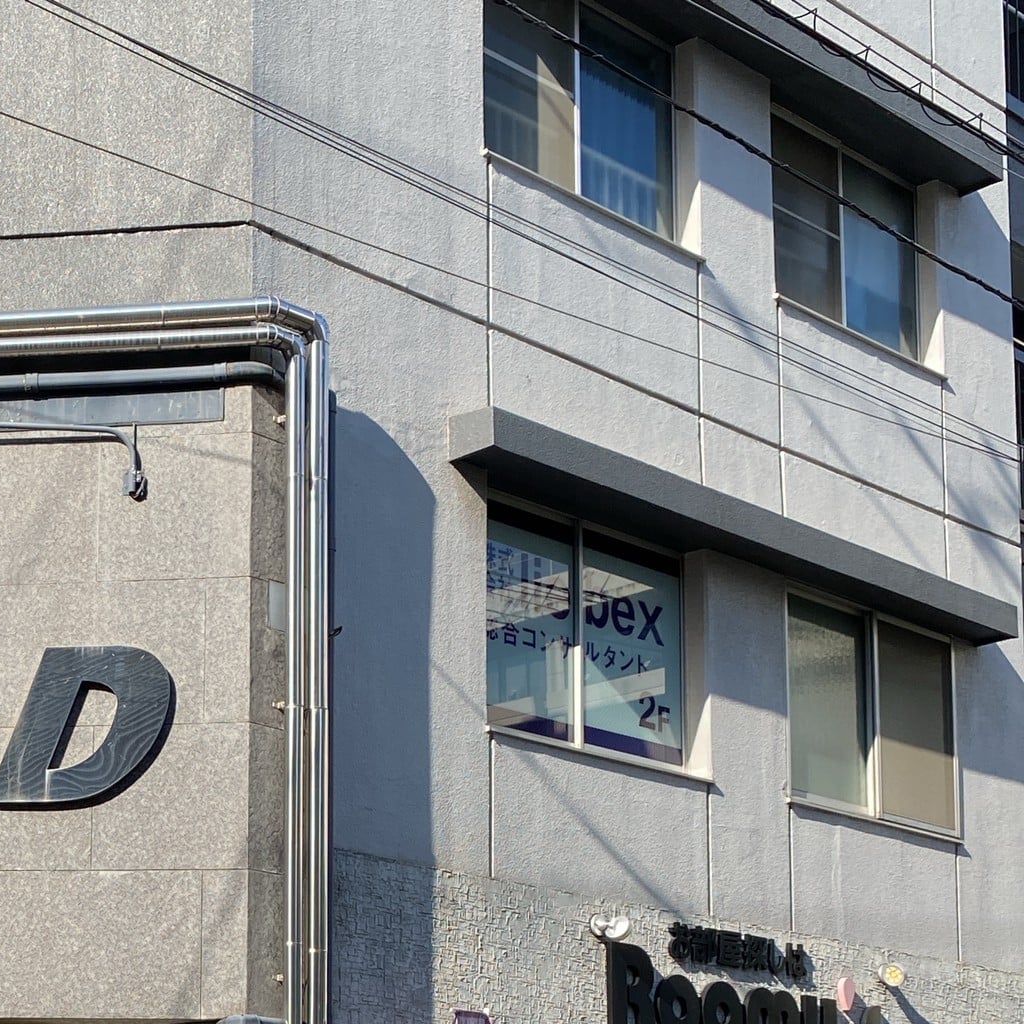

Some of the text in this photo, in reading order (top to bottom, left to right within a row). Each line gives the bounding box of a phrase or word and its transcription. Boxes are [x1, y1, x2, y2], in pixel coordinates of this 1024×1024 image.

[638, 692, 671, 733] 2F
[668, 921, 808, 979] お部屋探しは
